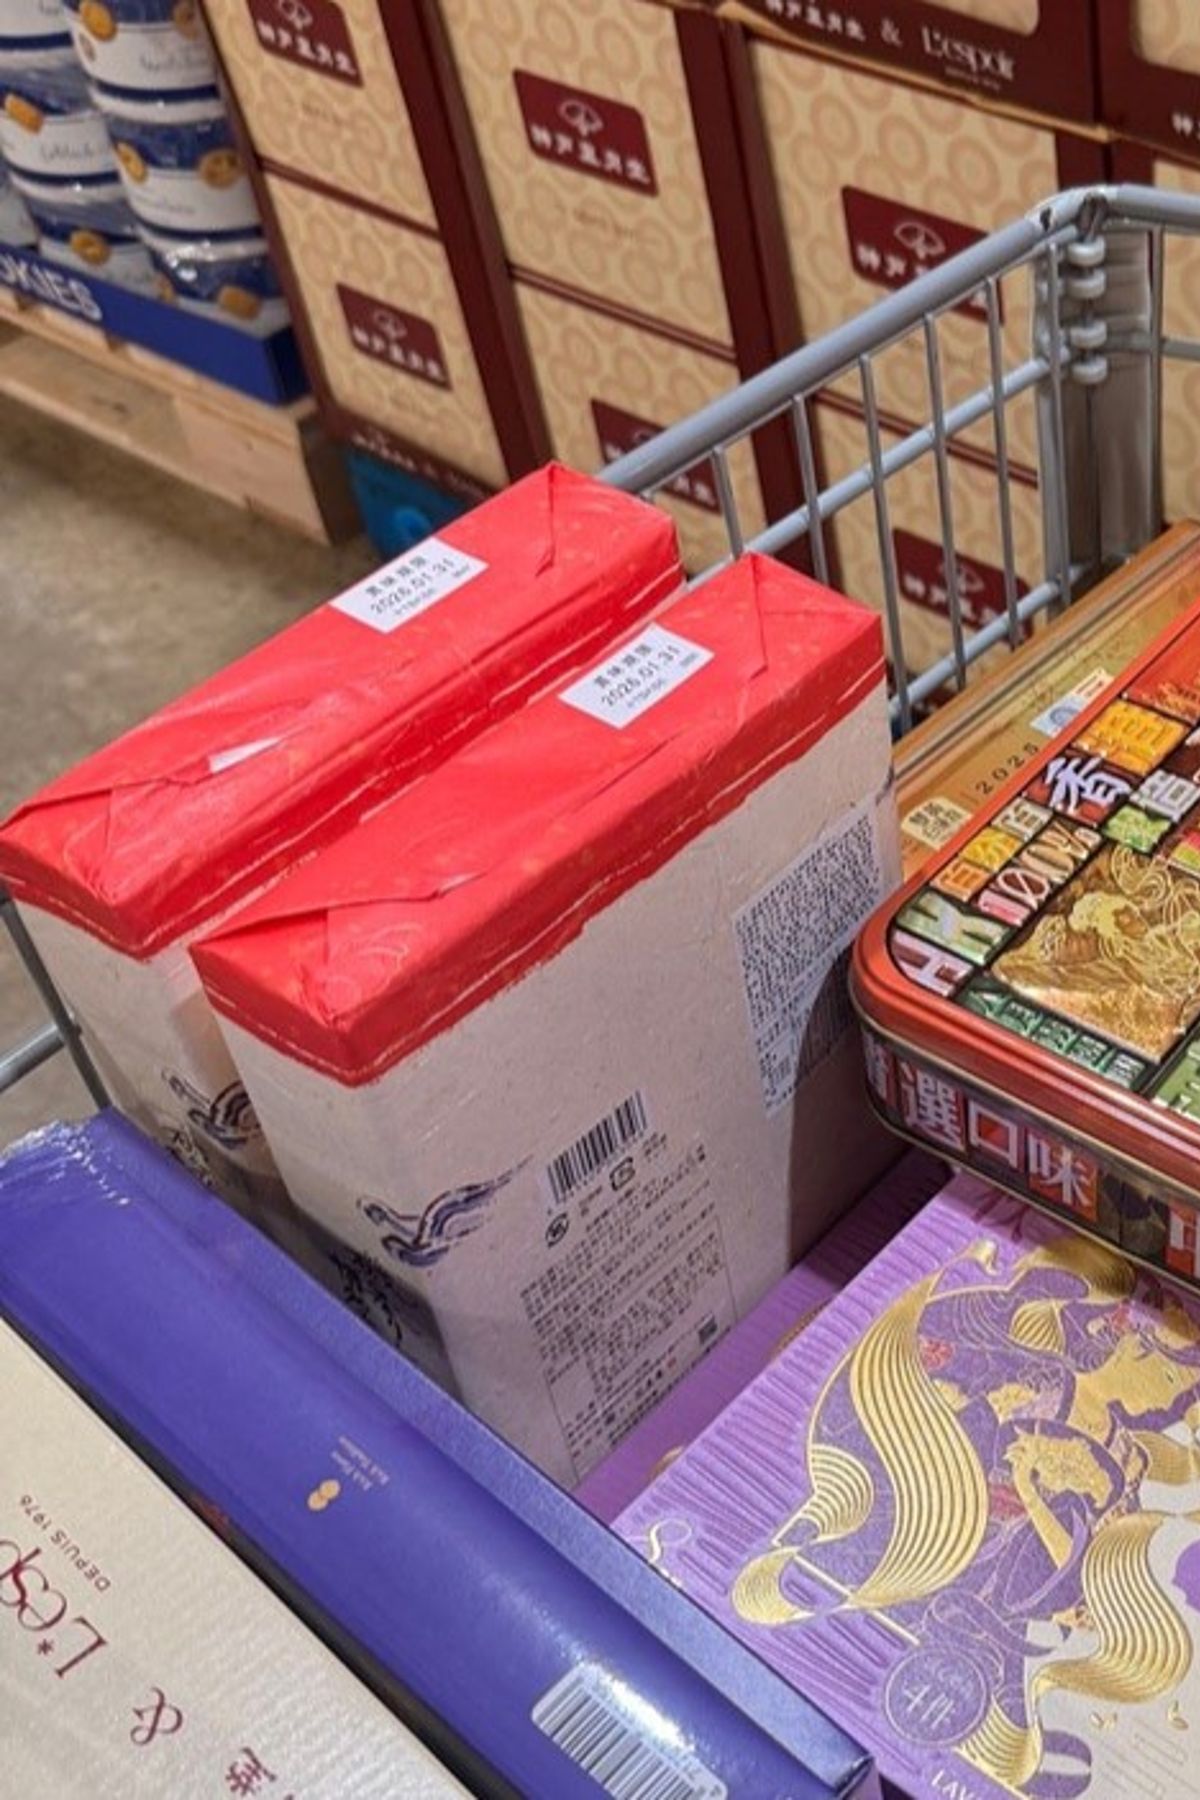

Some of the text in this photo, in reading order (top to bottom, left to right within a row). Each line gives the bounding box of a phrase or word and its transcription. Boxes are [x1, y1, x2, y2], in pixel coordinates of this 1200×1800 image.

[881, 17, 903, 48] &
[19, 1494, 111, 1592] DEPUIS 1976
[130, 1687, 184, 1746] &
